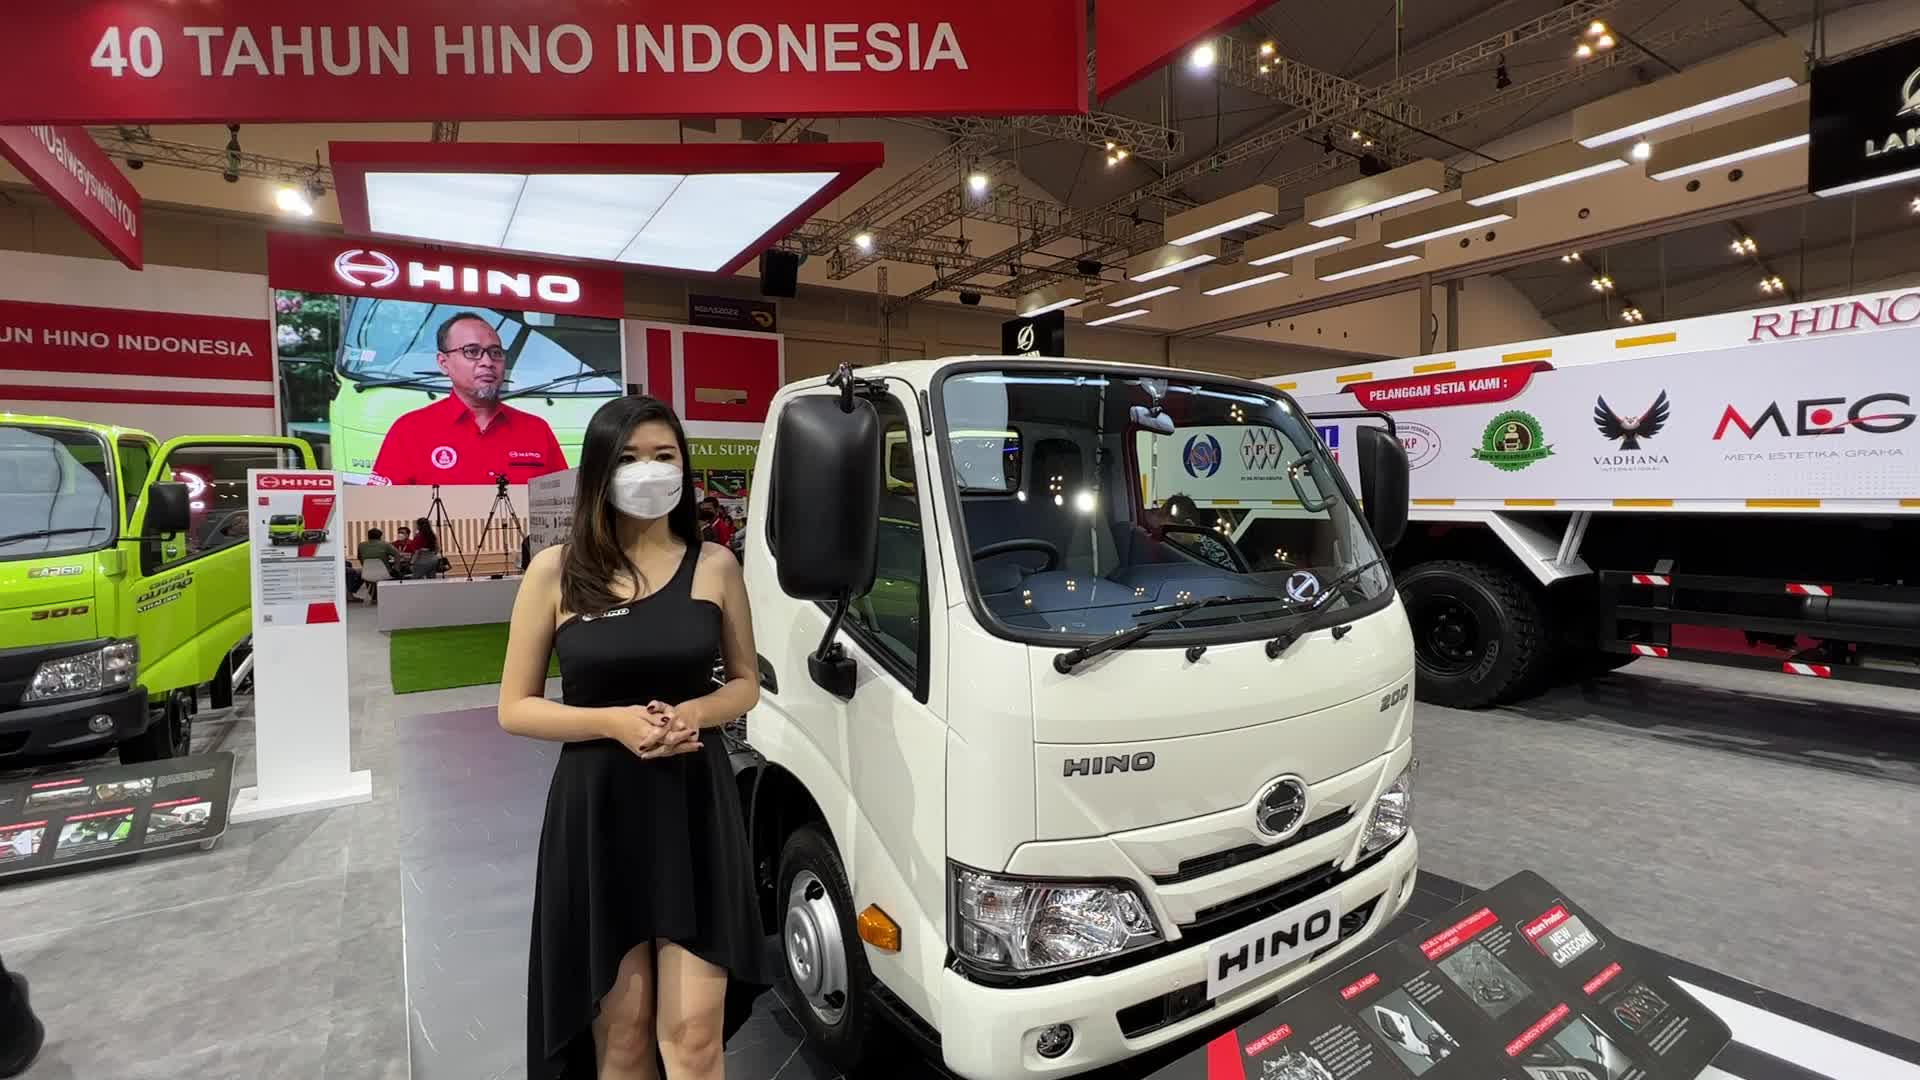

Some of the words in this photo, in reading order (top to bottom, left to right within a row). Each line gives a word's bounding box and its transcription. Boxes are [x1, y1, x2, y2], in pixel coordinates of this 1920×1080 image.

[90, 26, 164, 77] 40
[184, 25, 409, 76] TAHUN
[434, 23, 593, 75] HINO
[616, 22, 969, 73] INDONESIA
[408, 261, 580, 303] HINO
[1748, 292, 1920, 342] RHINO
[43, 329, 110, 348] HINO
[118, 334, 254, 357] INDONESIA
[1369, 384, 1431, 401] PELANGGAN
[1433, 380, 1466, 395] SETIA
[1469, 377, 1500, 392] KAMI
[1712, 392, 1917, 441] MEG
[1593, 455, 1669, 465] VADHANA
[1723, 452, 1764, 462] META
[1768, 449, 1842, 460] ESTETIKA
[1844, 447, 1905, 458] GRAHA
[281, 478, 333, 487] HINO
[1379, 683, 1409, 713] 200
[1063, 751, 1156, 777] HINO
[1218, 908, 1331, 981] HINO
[1549, 926, 1571, 947] NEW
[1552, 930, 1596, 963] CATEGORY
